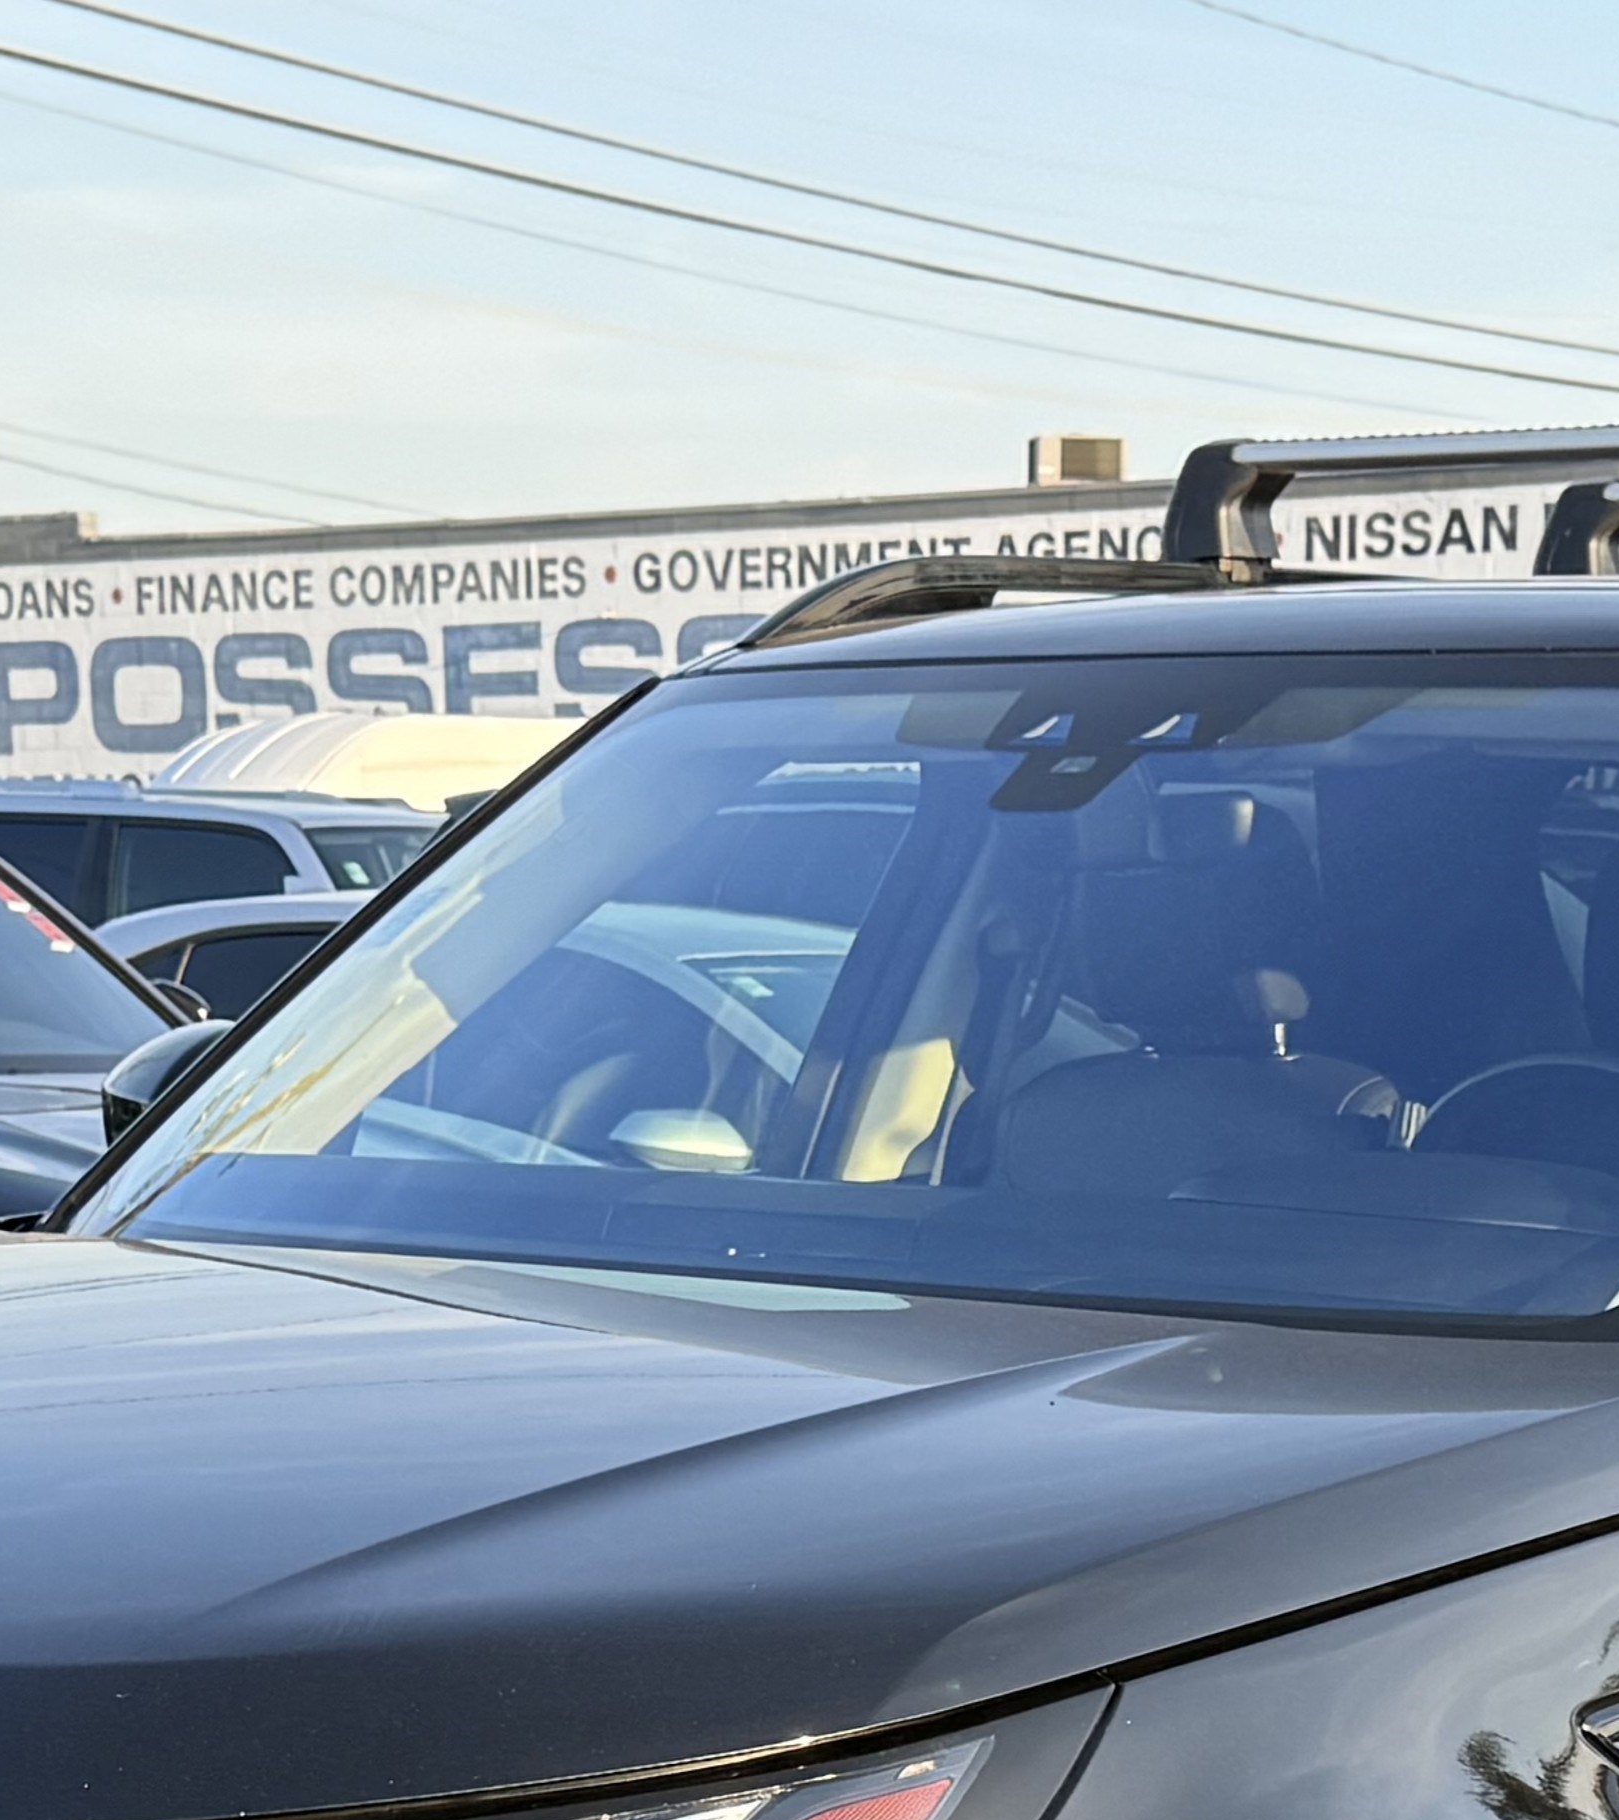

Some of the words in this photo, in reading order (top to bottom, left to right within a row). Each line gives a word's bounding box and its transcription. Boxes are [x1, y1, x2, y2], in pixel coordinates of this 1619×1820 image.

[136, 569, 315, 615] FINANCE
[330, 556, 587, 608] COMPANIES
[1305, 504, 1518, 561] NISSAN
